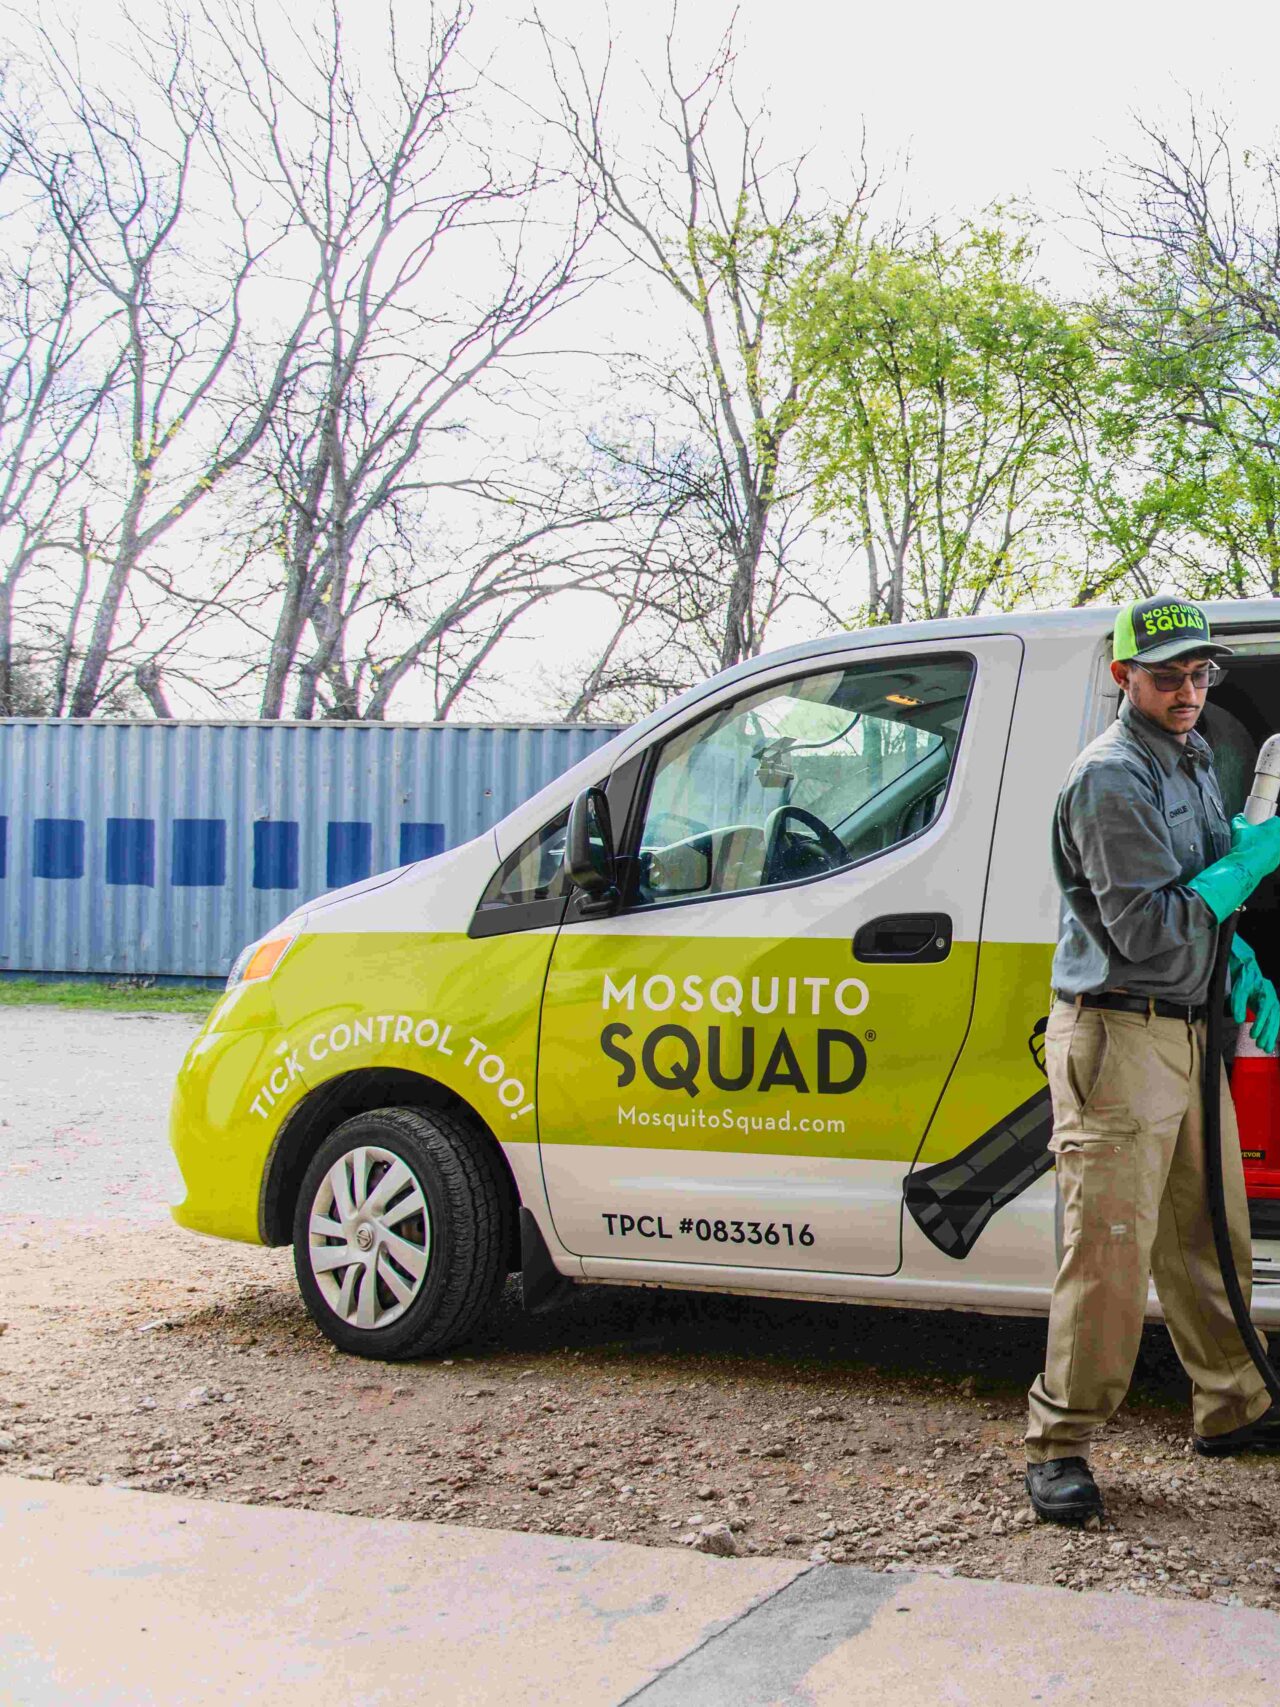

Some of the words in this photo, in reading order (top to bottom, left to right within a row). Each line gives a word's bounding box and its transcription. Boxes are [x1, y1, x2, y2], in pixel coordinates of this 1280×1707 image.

[1142, 604, 1200, 621] MOSQUITO
[1145, 613, 1205, 636] SQUAD
[602, 973, 870, 1017] MOSQUITO
[250, 1048, 305, 1120] TICK
[308, 1015, 454, 1061] CONTROL
[463, 1036, 536, 1121] TOO!
[617, 1105, 846, 1135] MosquitoSquad.com
[601, 1213, 673, 1239] TPCL
[679, 1217, 816, 1246] #0833616
